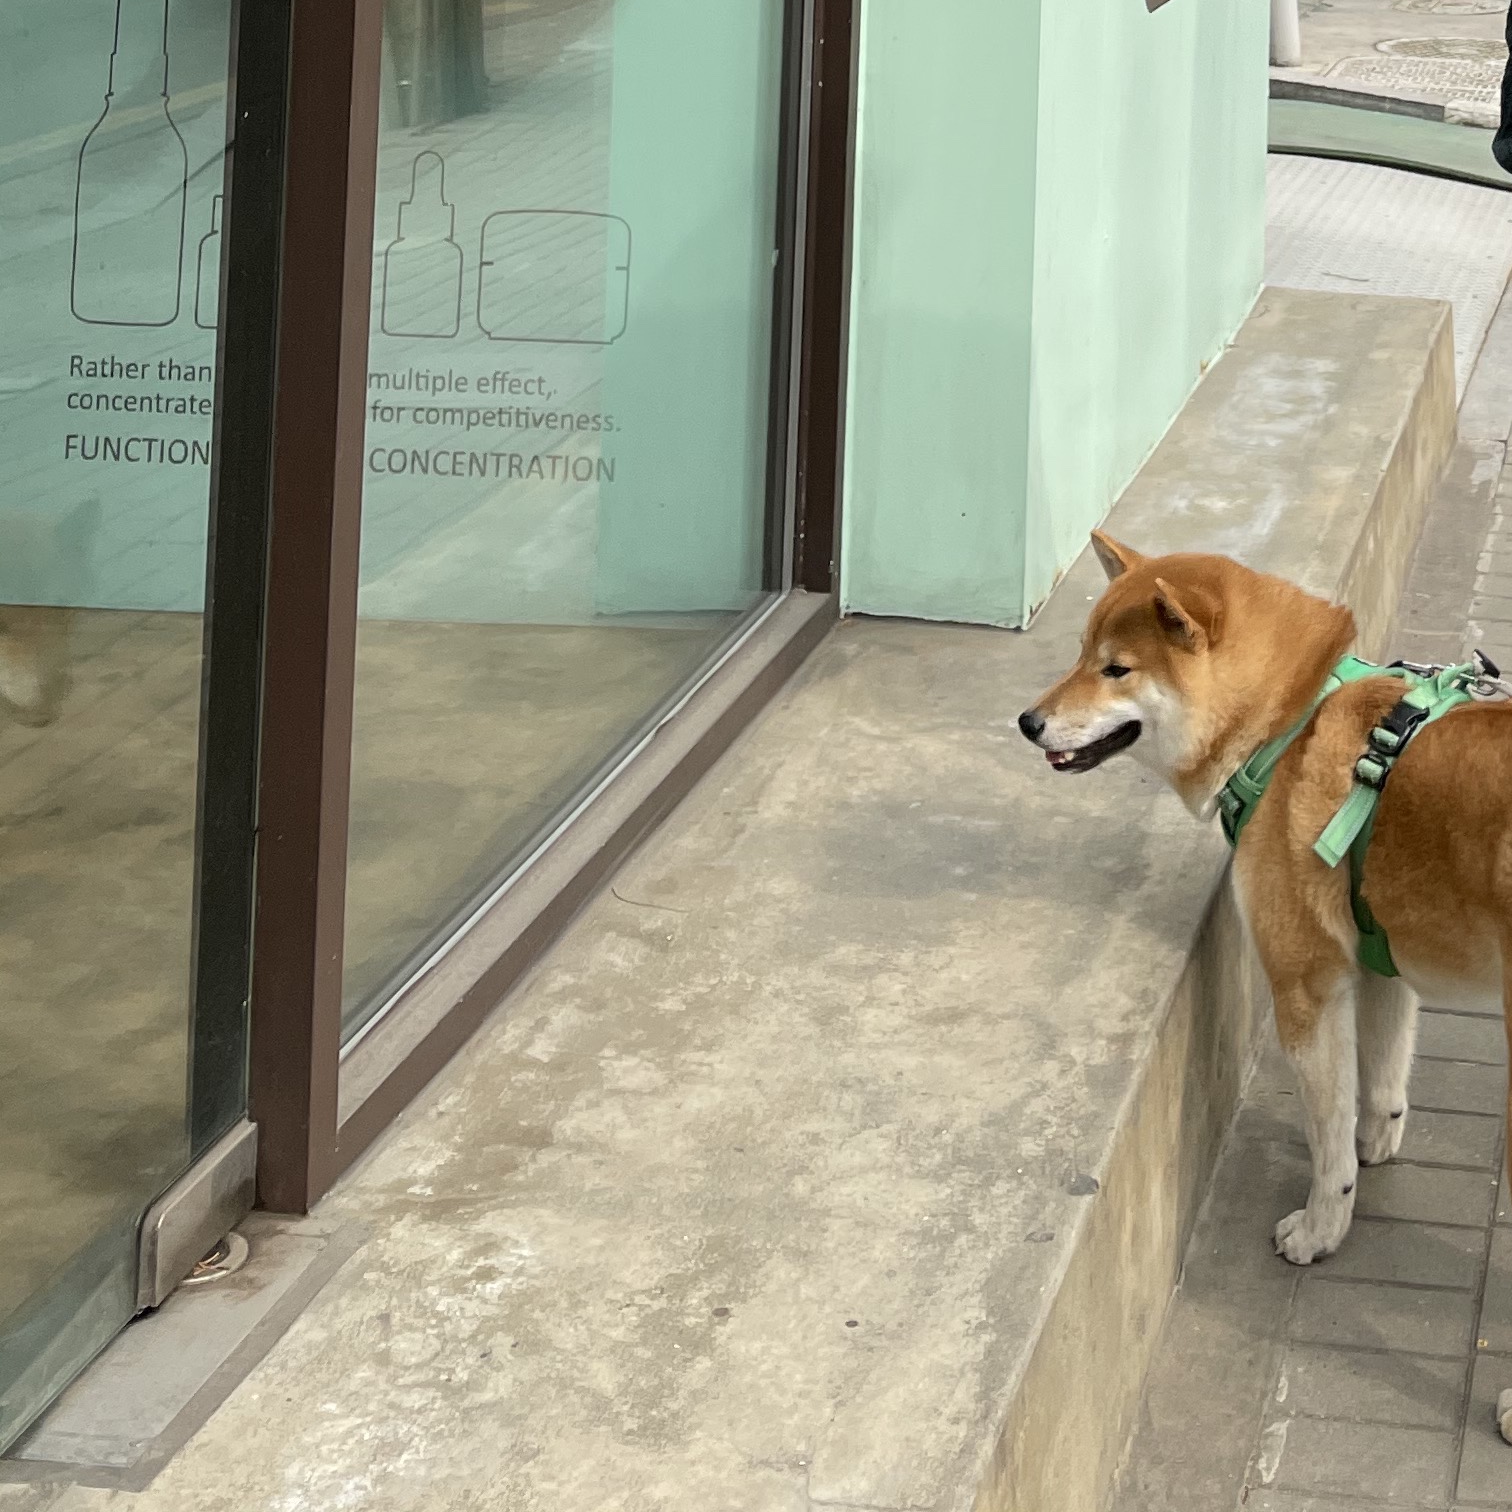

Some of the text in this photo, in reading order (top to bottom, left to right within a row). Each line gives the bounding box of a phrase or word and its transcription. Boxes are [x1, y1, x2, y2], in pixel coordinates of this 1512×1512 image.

[70, 354, 150, 380] Rather
[157, 357, 212, 382] than
[367, 368, 469, 397] multiple
[67, 392, 622, 432] concentrate for competitiveness.
[64, 434, 616, 483] FUNCTION CONCENTRATION
